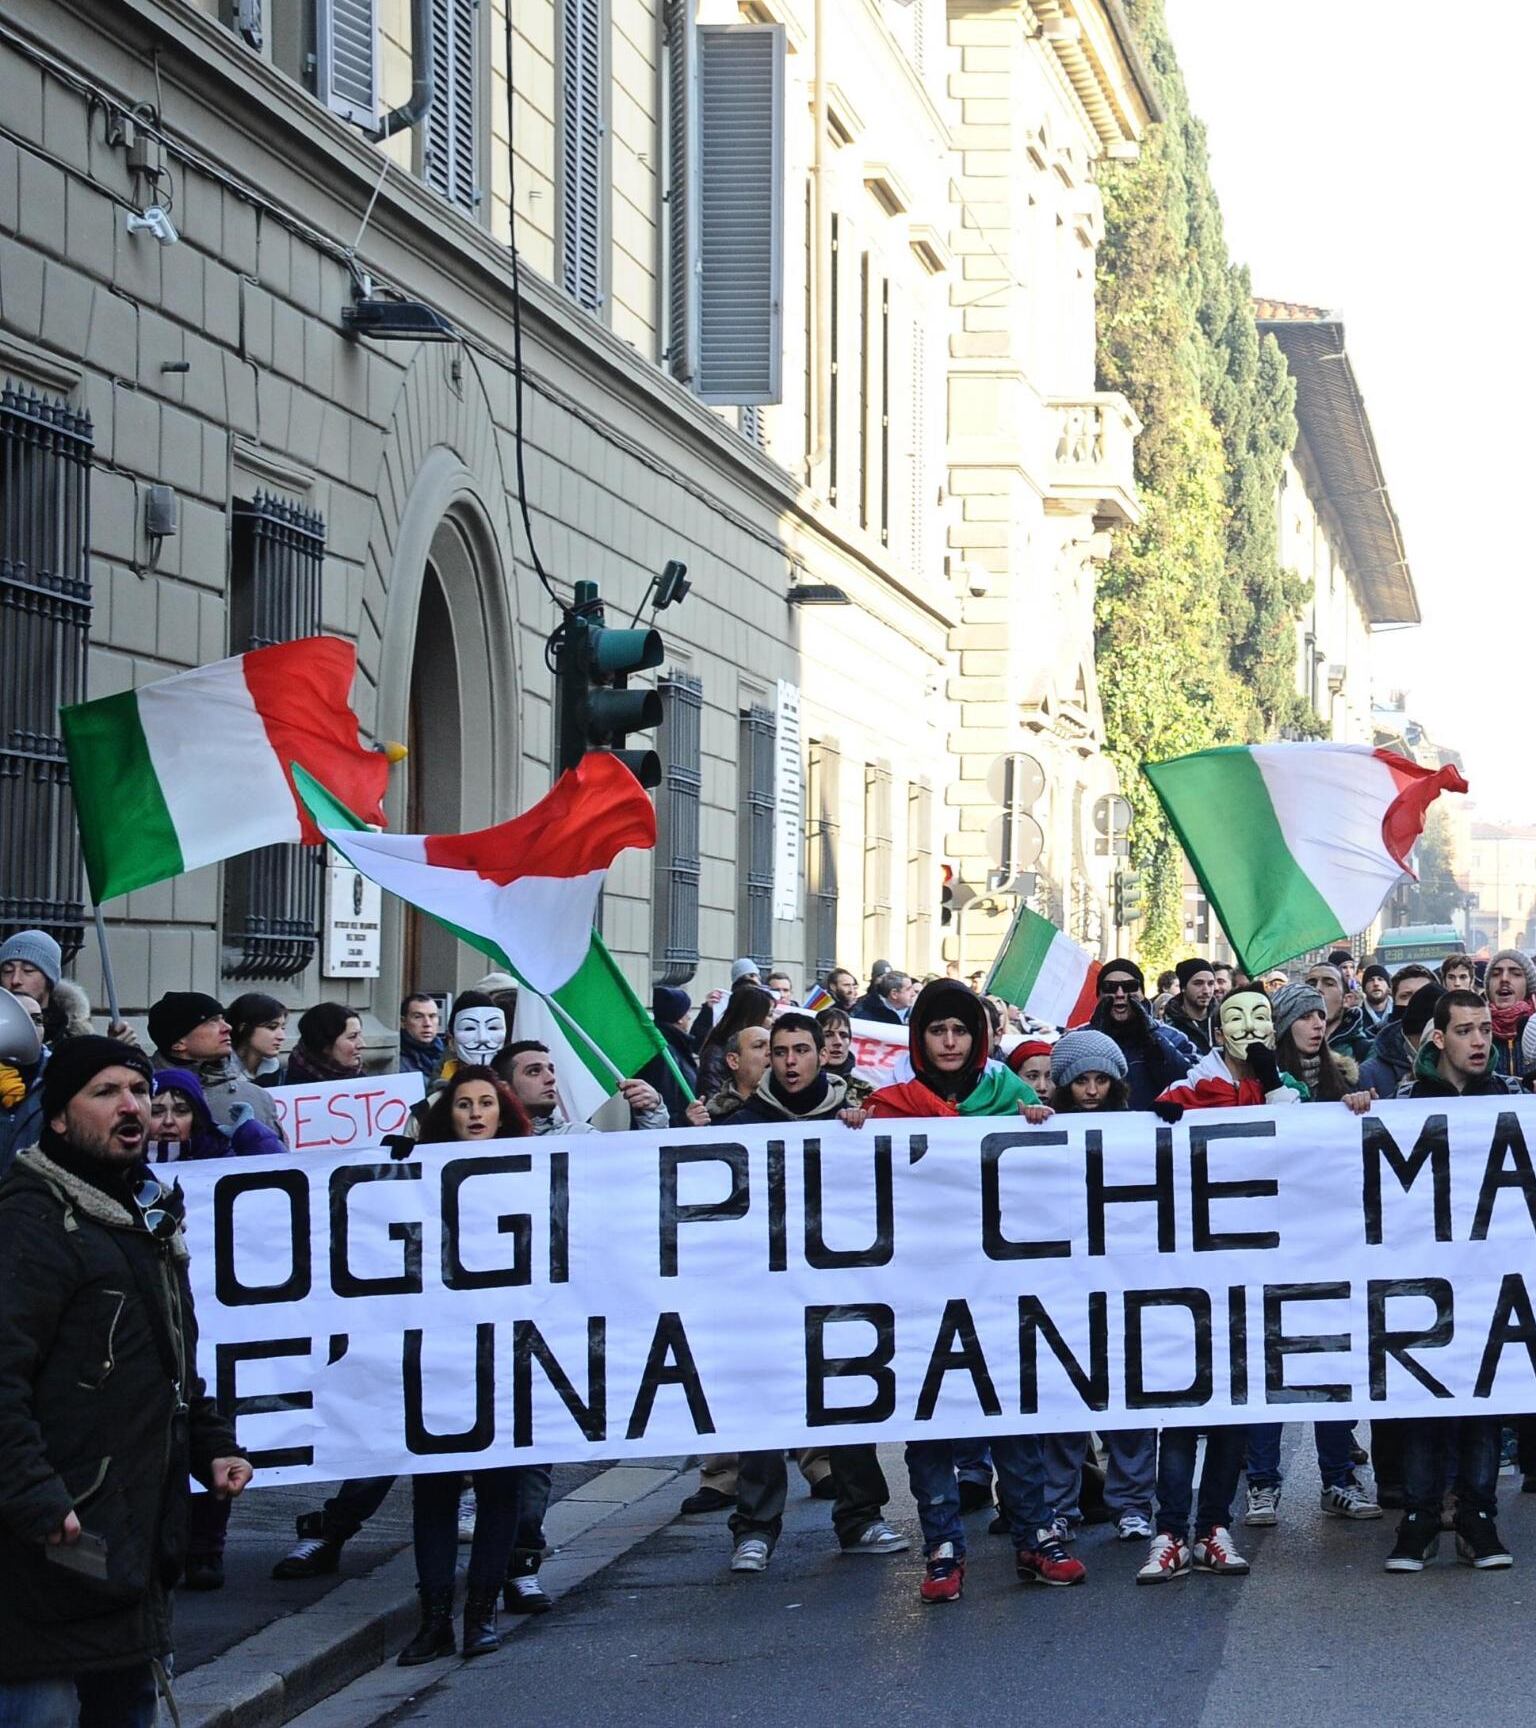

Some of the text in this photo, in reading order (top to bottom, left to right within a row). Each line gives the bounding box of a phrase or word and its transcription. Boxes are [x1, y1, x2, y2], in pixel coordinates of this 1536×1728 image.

[214, 1153, 569, 1306] OGGI
[659, 1135, 928, 1277] PIU'
[981, 1120, 1280, 1261] CHE
